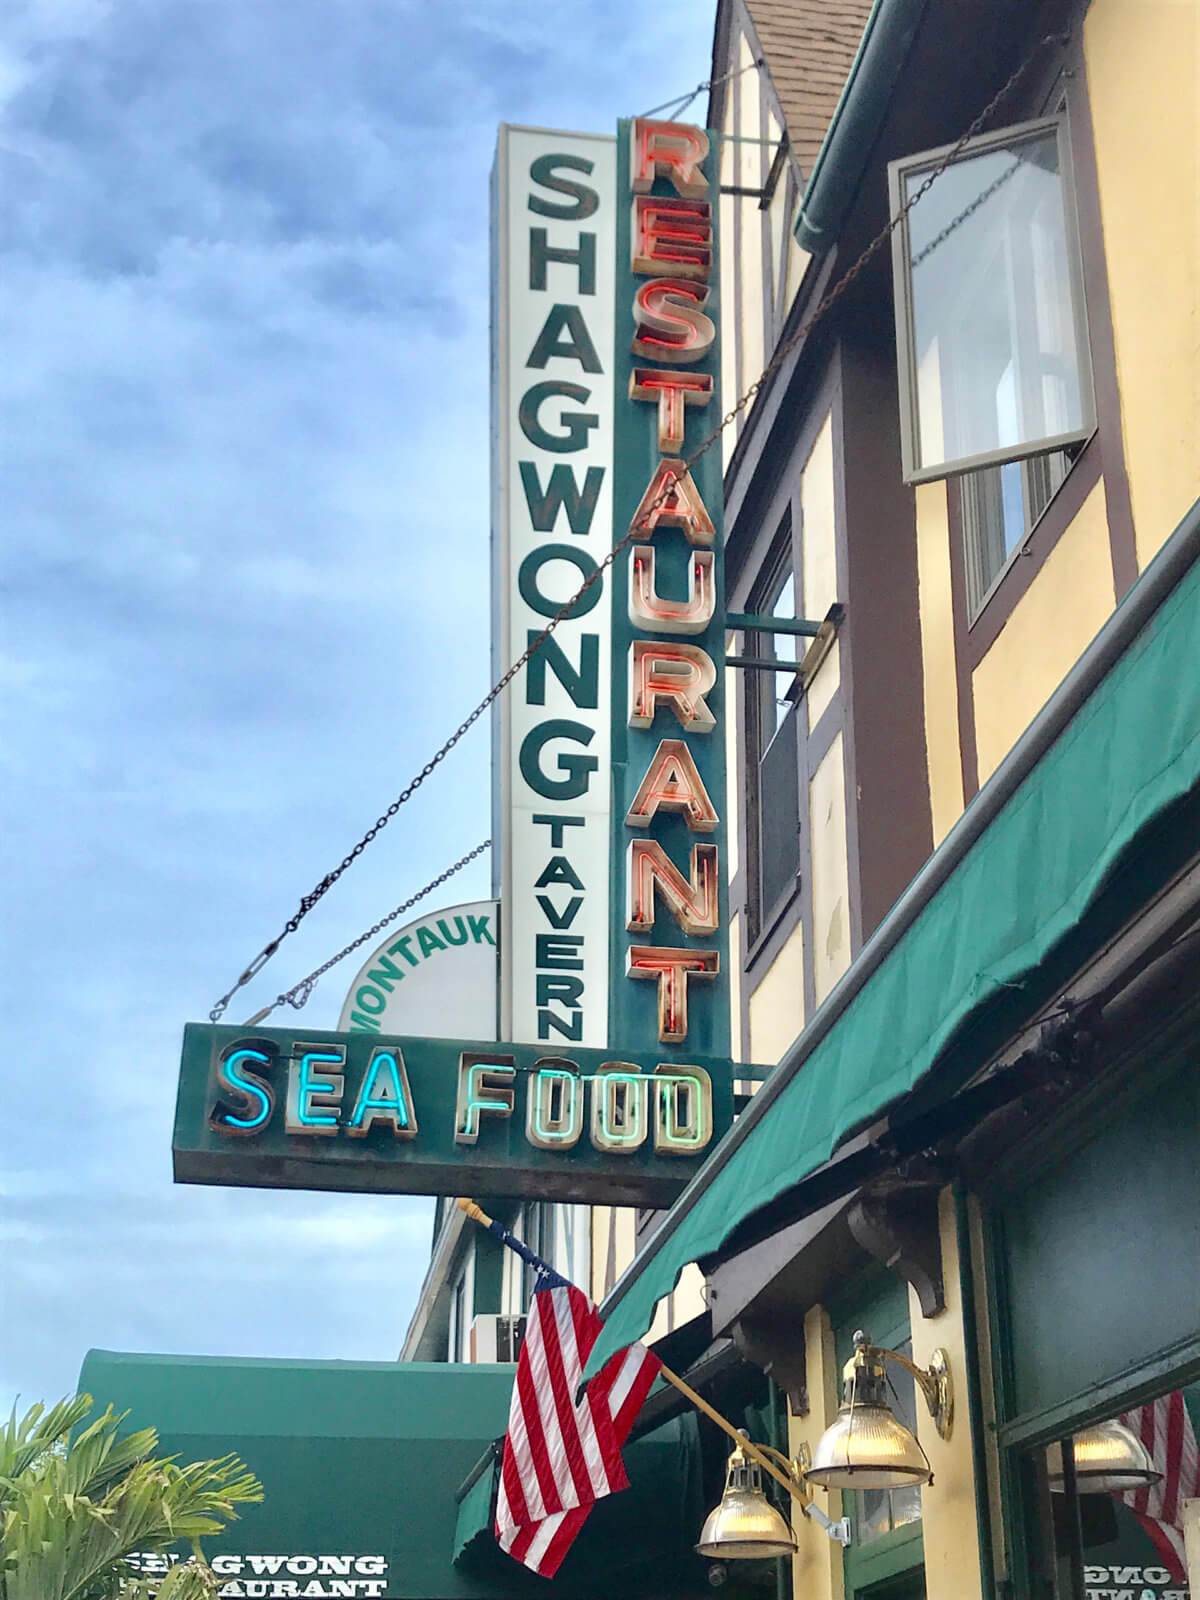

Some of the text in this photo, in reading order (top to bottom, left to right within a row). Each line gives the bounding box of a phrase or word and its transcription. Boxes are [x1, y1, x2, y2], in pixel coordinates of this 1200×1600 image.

[518, 153, 606, 1042] SHAGWONG TAVERN
[625, 118, 721, 1045] RESTAURANT
[209, 1037, 713, 1155] SEA FOOD
